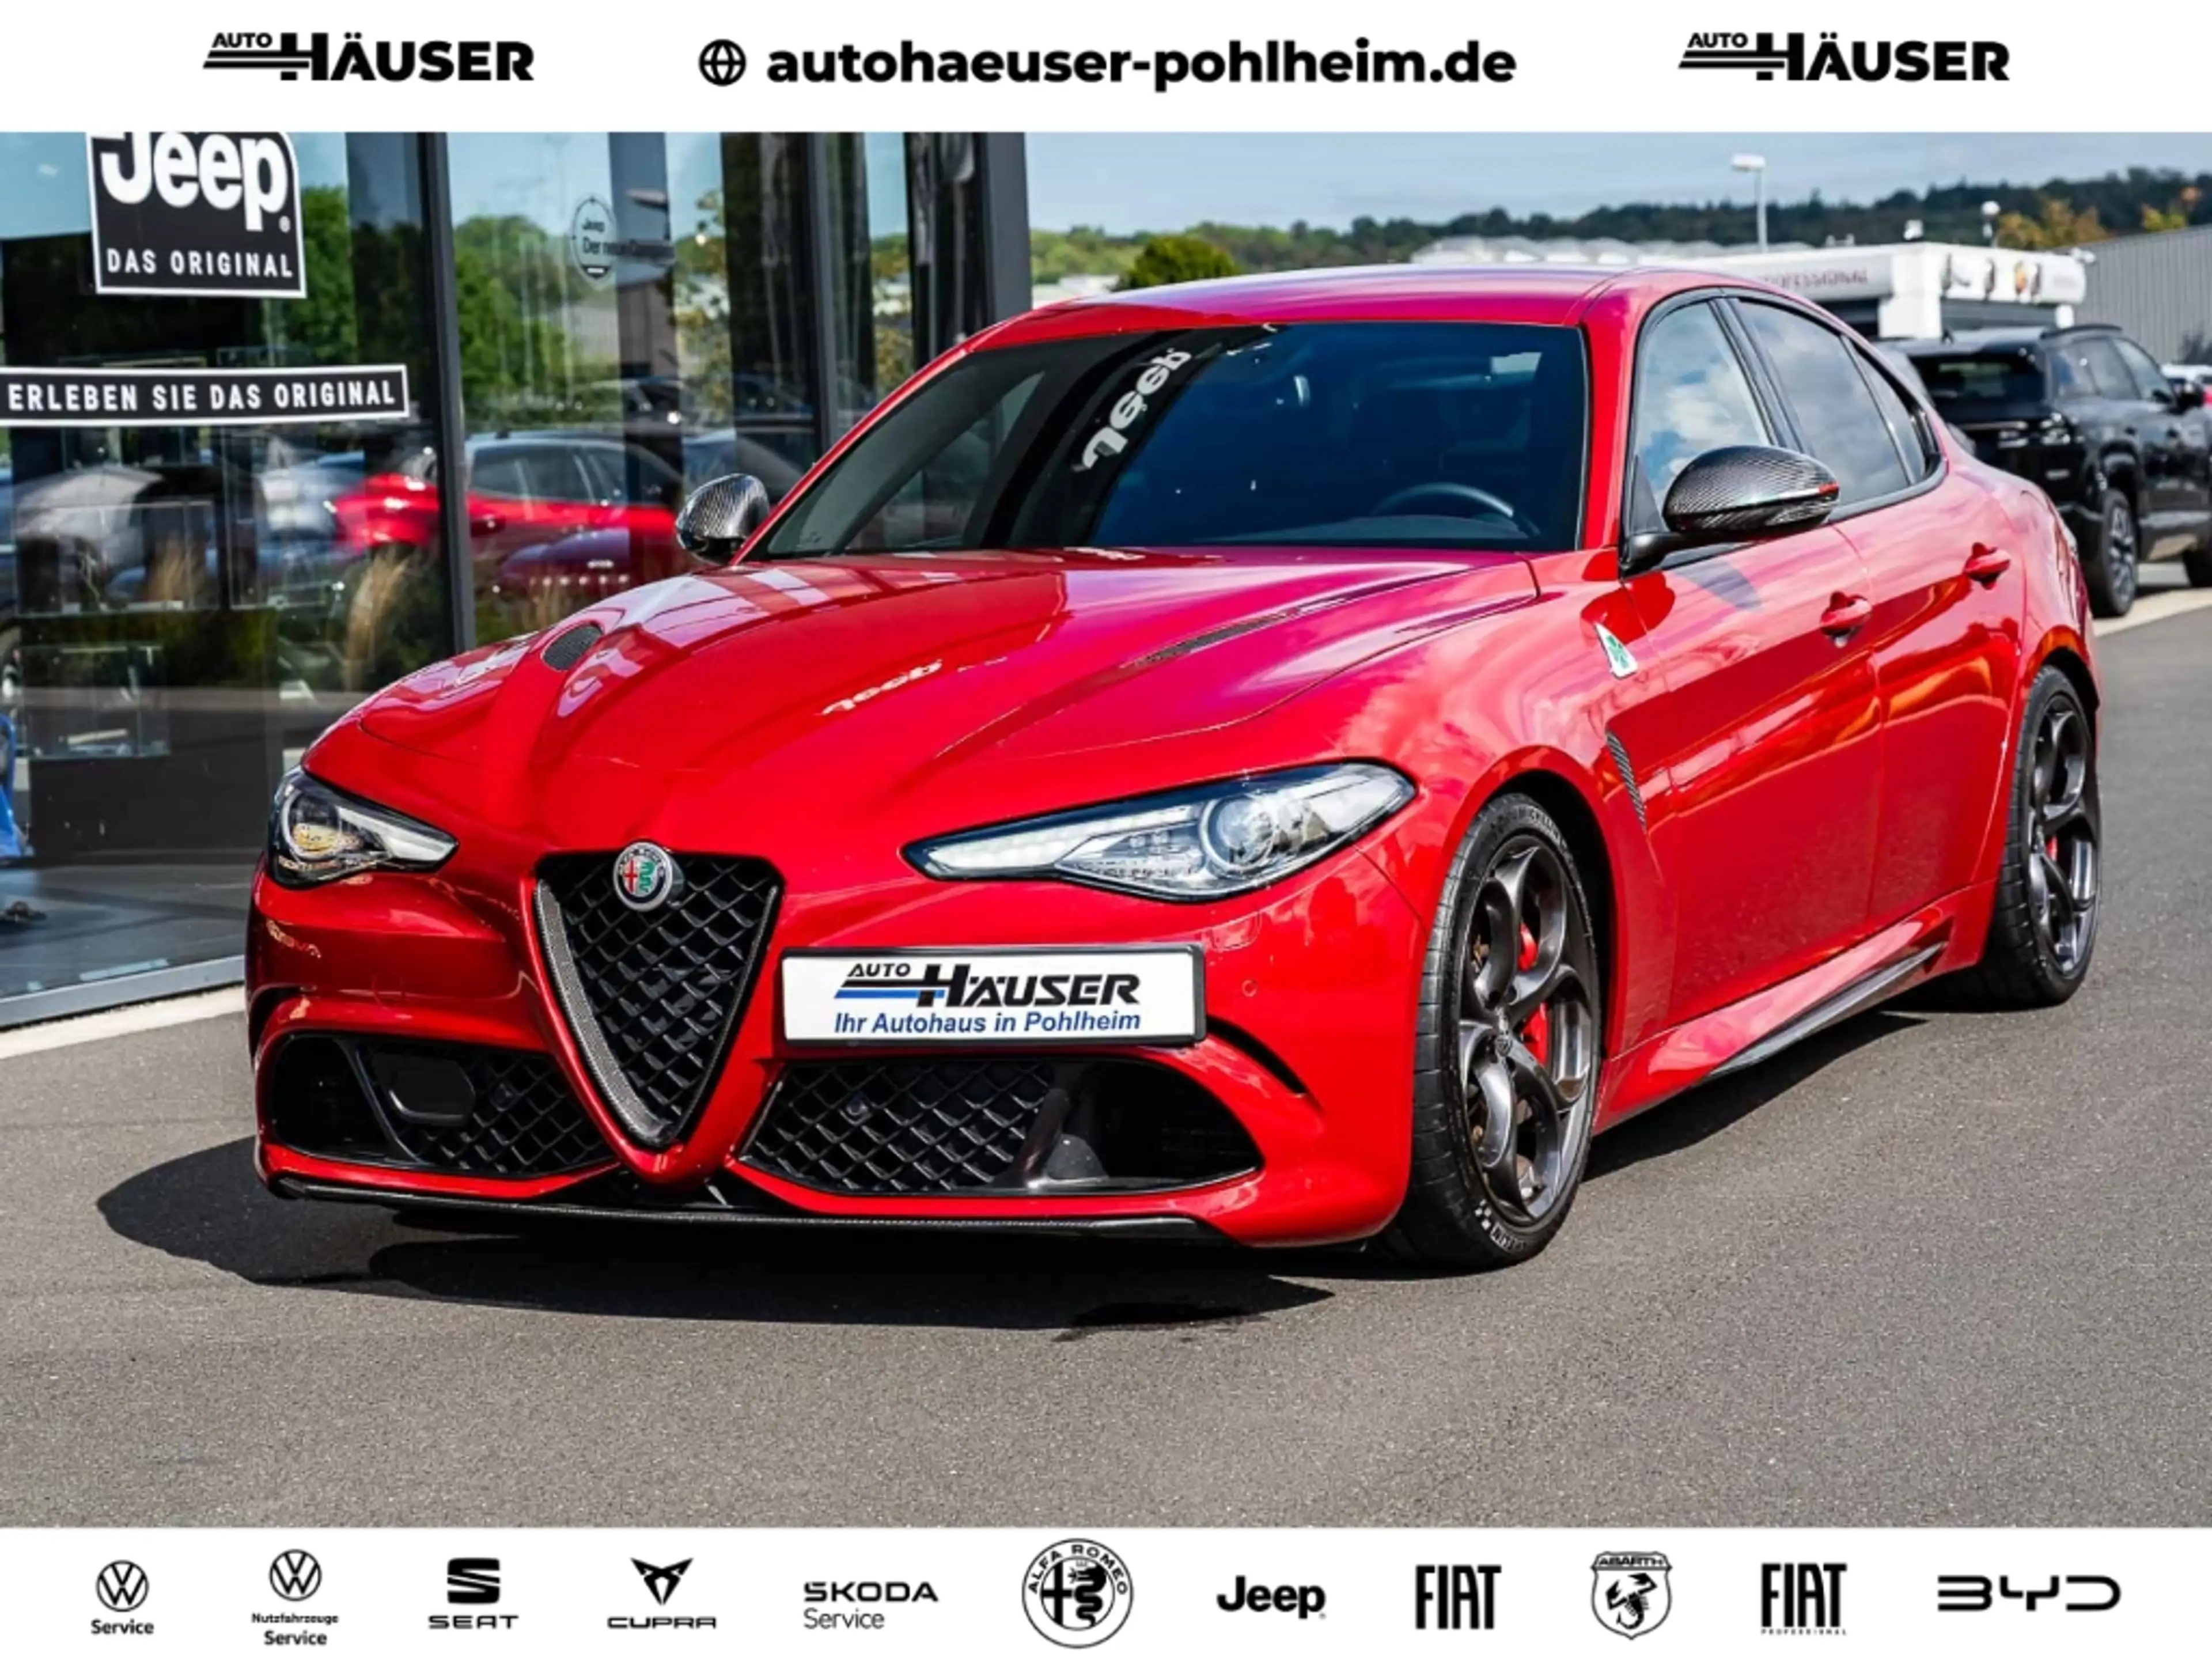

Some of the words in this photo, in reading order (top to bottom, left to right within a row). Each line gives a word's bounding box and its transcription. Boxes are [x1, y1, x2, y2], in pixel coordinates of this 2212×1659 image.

[107, 248, 156, 274] DAS
[171, 251, 293, 278] ORIGINAL
[8, 384, 138, 411] ERLEBEN
[153, 384, 198, 411] SIE
[210, 384, 261, 410] DAS
[274, 380, 395, 408] ORIGINAL
[848, 963, 911, 978] AUTO
[917, 964, 1140, 1007] HÄUSER
[835, 1012, 868, 1033] Ihr
[872, 1012, 987, 1034] Autohaus
[994, 1012, 1017, 1032] in
[1024, 1010, 1141, 1033] Pohlheim
